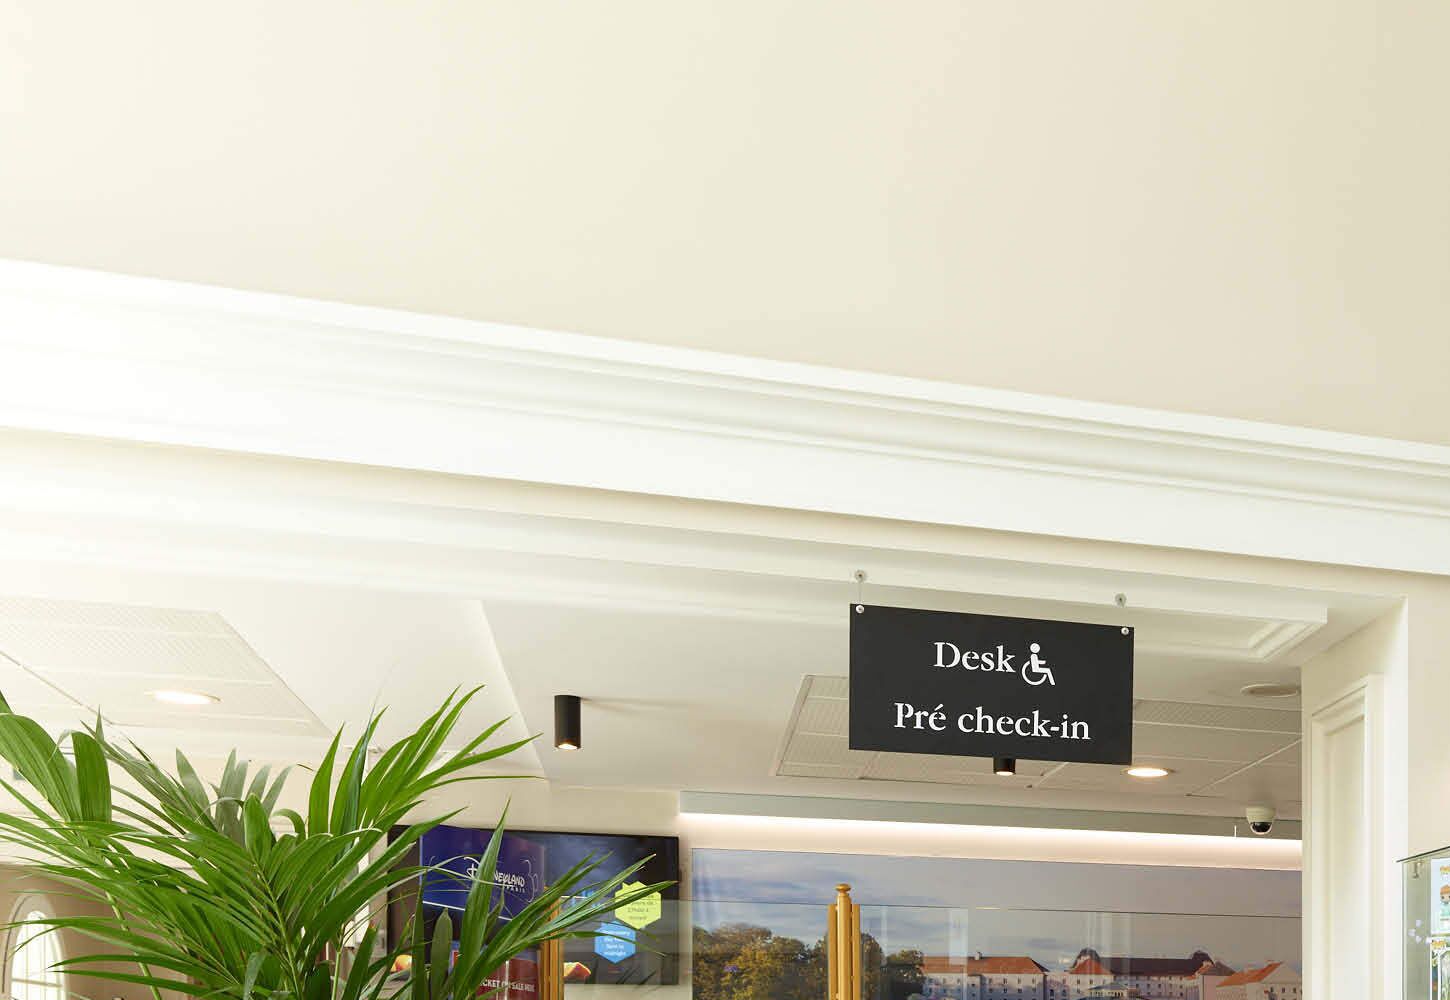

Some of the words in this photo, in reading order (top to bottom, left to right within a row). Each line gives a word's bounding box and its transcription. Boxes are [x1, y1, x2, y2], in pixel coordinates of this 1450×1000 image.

[933, 641, 1016, 674] Desk
[894, 702, 947, 731] Pré
[958, 706, 1092, 740] check-in
